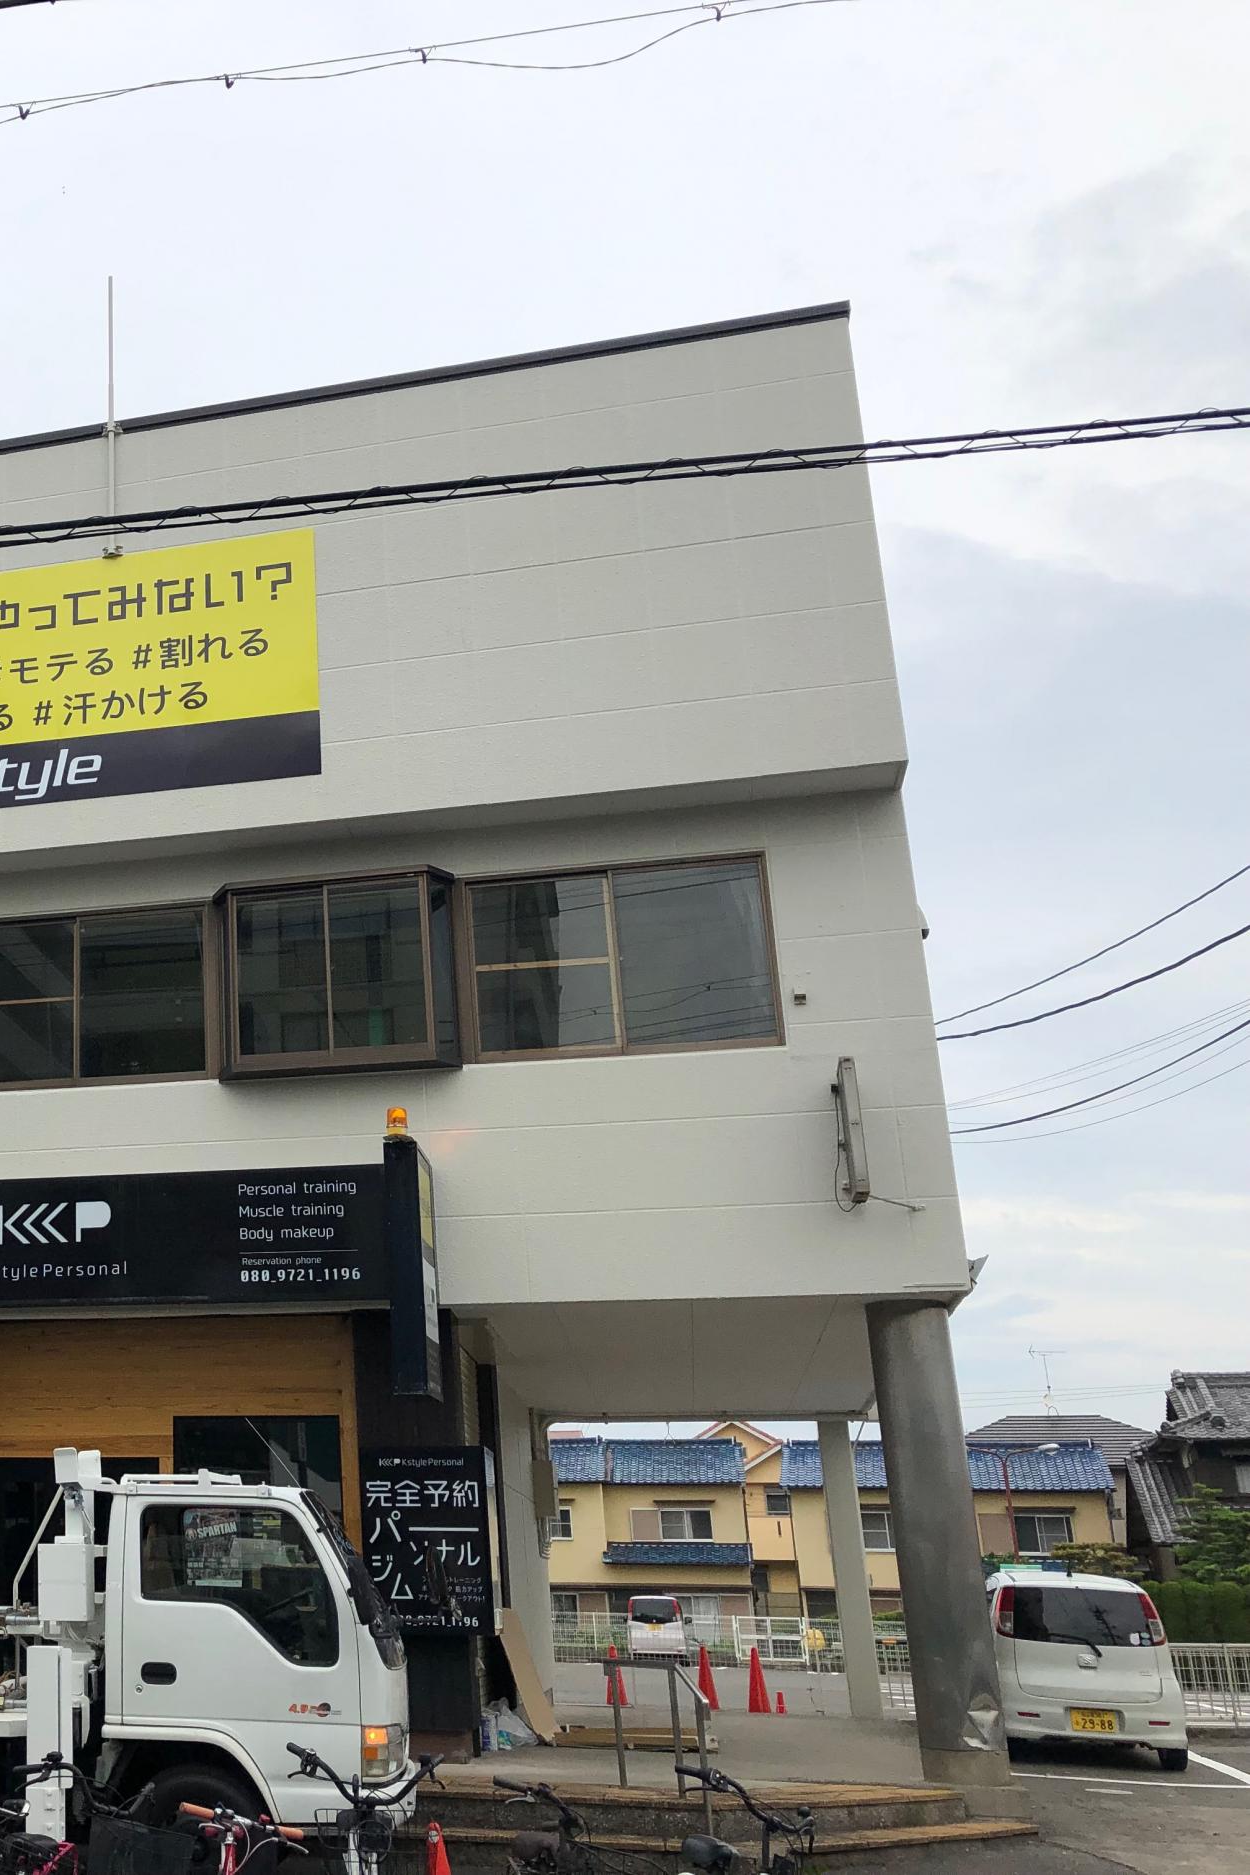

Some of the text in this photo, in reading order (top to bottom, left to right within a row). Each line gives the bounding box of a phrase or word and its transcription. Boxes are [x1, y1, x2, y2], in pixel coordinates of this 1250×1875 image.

[132, 628, 269, 669] #割れる
[34, 681, 208, 727] #汗かける
[238, 1180, 357, 1196] Personal training
[239, 1202, 344, 1218] Muscle training
[239, 1225, 334, 1241] Body makeup
[242, 1256, 322, 1266] Reservation phone
[365, 1480, 480, 1508] 完全予約
[197, 1521, 237, 1539] SPARTAN
